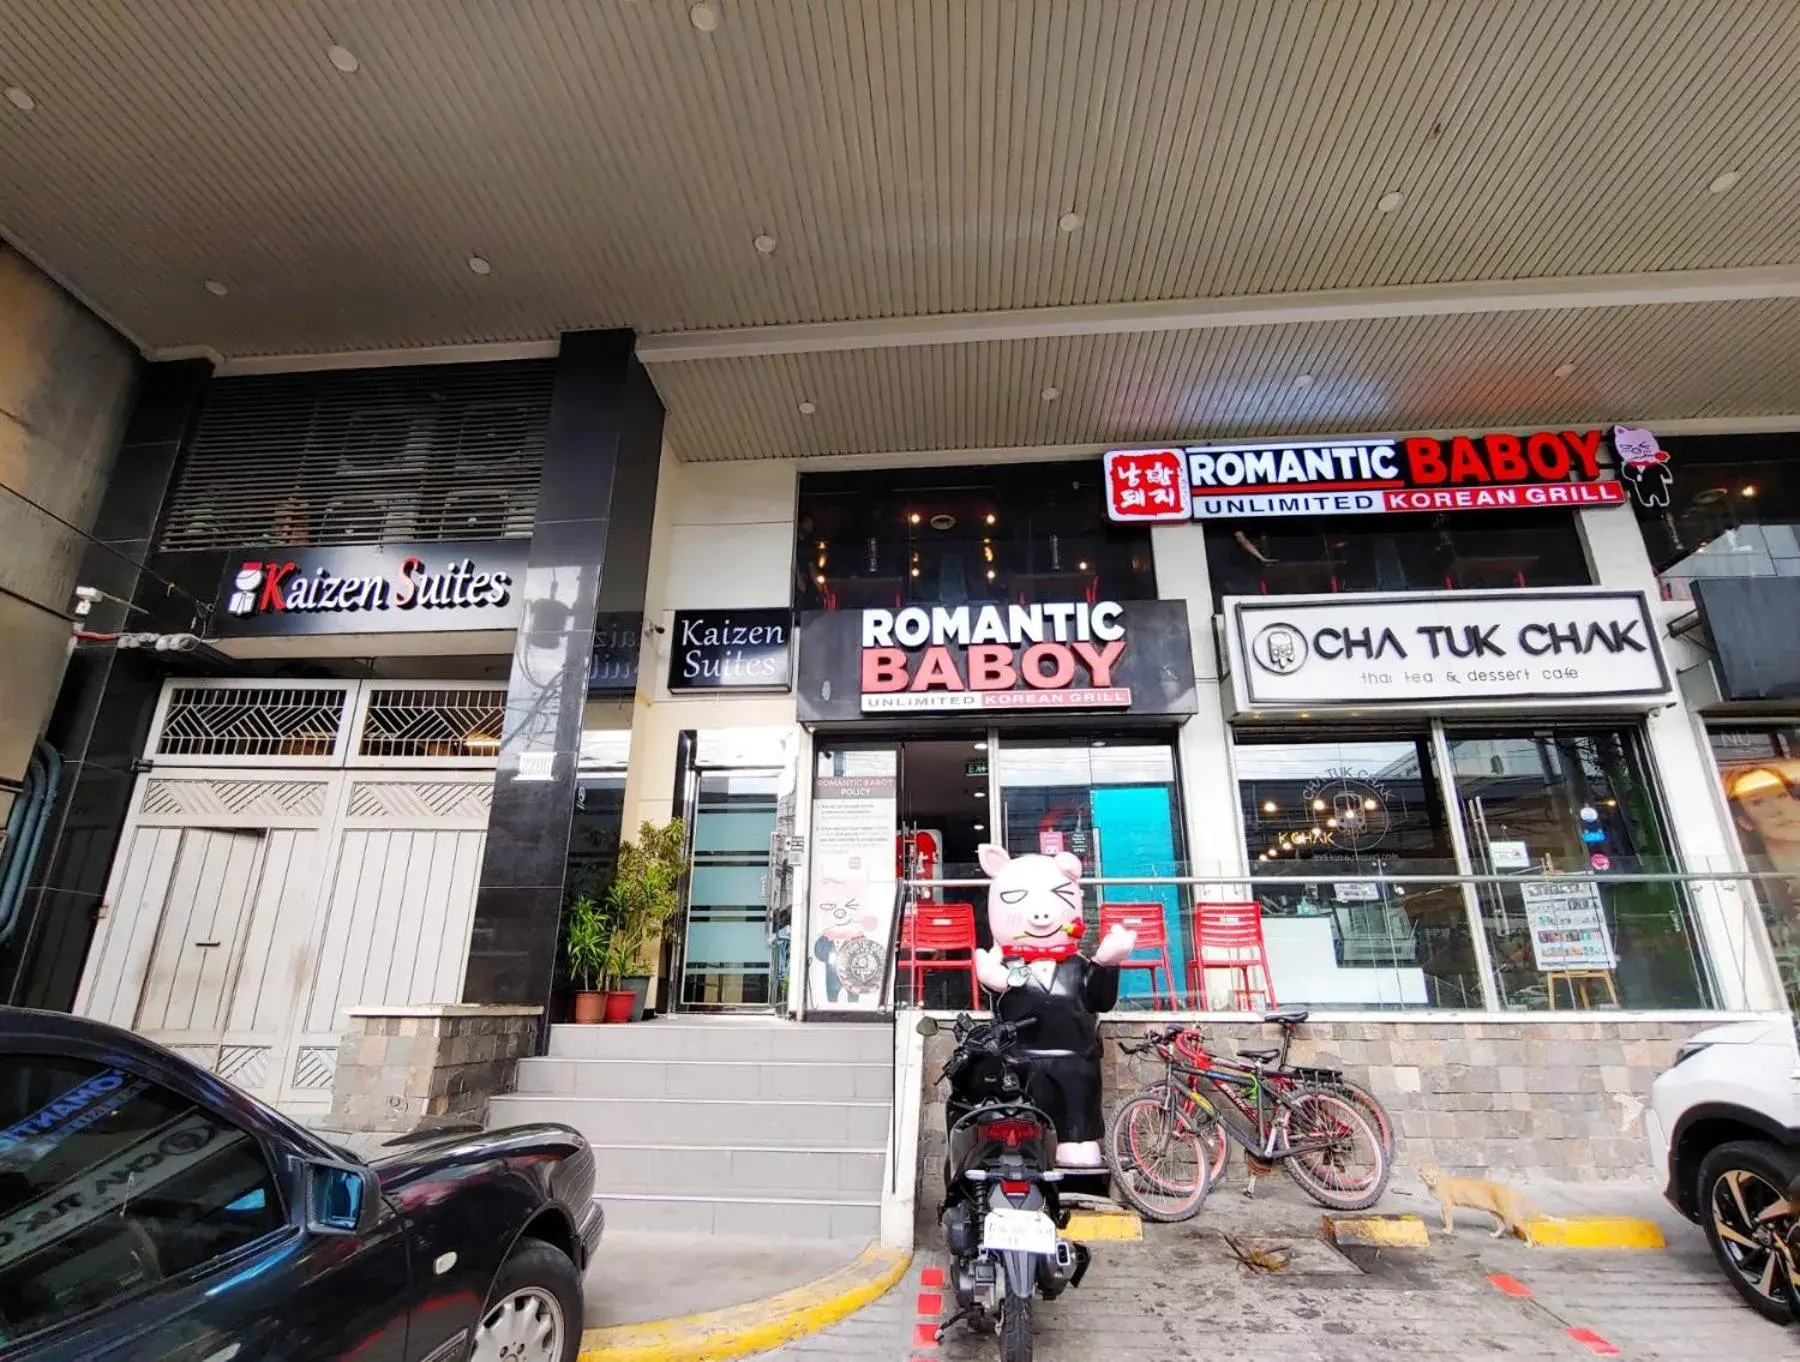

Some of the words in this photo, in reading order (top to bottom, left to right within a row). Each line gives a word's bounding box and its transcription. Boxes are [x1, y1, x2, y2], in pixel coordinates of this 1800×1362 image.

[1189, 445, 1399, 486] ROMANTIC
[1404, 430, 1602, 485] BABOY
[1205, 495, 1373, 514] UNLIMITED
[1390, 488, 1516, 509] KOREAN
[1526, 485, 1618, 503] GRILL
[260, 562, 386, 612] Kaizen
[396, 555, 508, 607] Suites
[682, 619, 784, 646] Kaizen
[862, 601, 1127, 648] ROMANTIC
[1313, 627, 1408, 660] CHA
[1416, 624, 1506, 659] TUK
[1519, 620, 1647, 656] CHAK
[684, 650, 775, 678] Suites
[861, 641, 1127, 693] BABOY
[1361, 671, 1393, 684] thai
[1405, 671, 1433, 683] tea
[1447, 671, 1460, 684] &
[1468, 668, 1529, 682] dessert
[1543, 667, 1579, 680] cafe
[868, 696, 976, 708] UNLIMITED
[985, 694, 1063, 705] KOREAN
[1070, 691, 1126, 703] GRILL
[841, 787, 870, 796] POLICY
